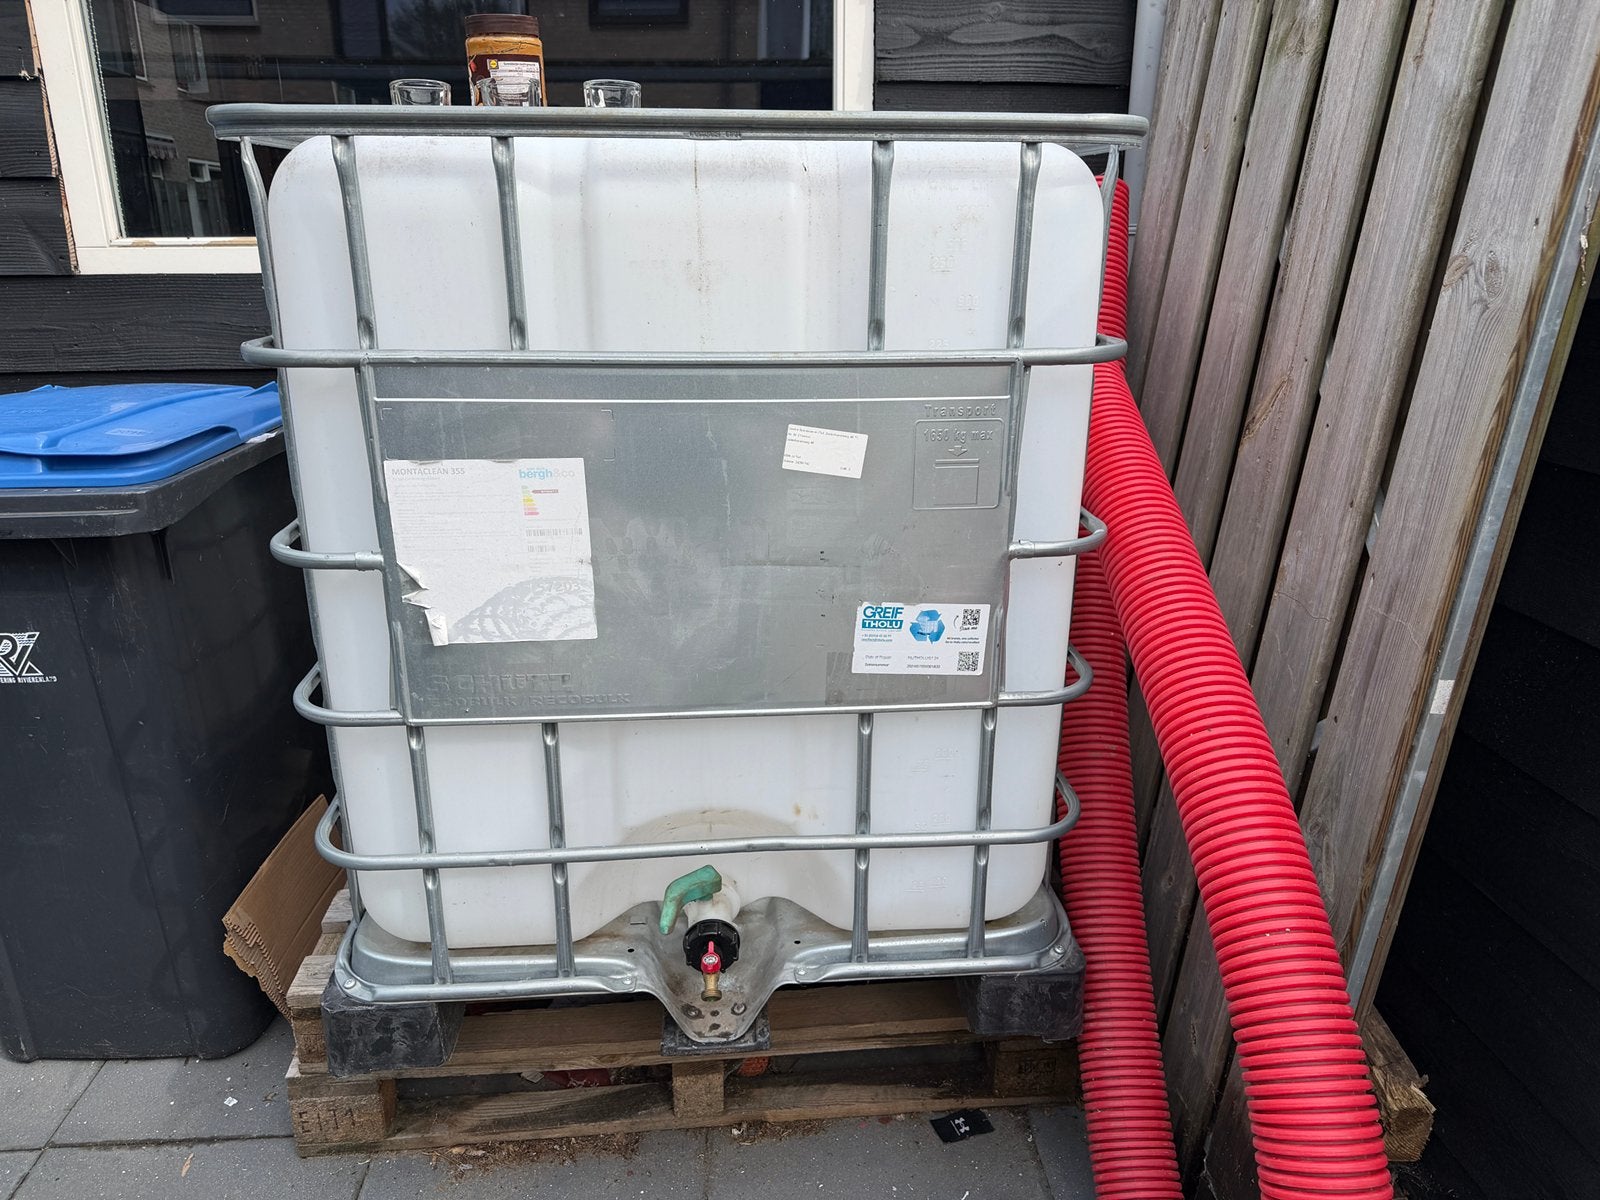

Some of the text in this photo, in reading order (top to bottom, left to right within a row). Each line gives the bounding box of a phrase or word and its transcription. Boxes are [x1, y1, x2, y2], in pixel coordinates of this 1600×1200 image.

[924, 403, 996, 418] Transport
[923, 427, 993, 445] 1650 kg max
[391, 467, 466, 477] MONTACLEAN 355
[518, 467, 576, 481] bergh&co
[863, 605, 905, 619] GREIF
[863, 620, 901, 629] THOLU
